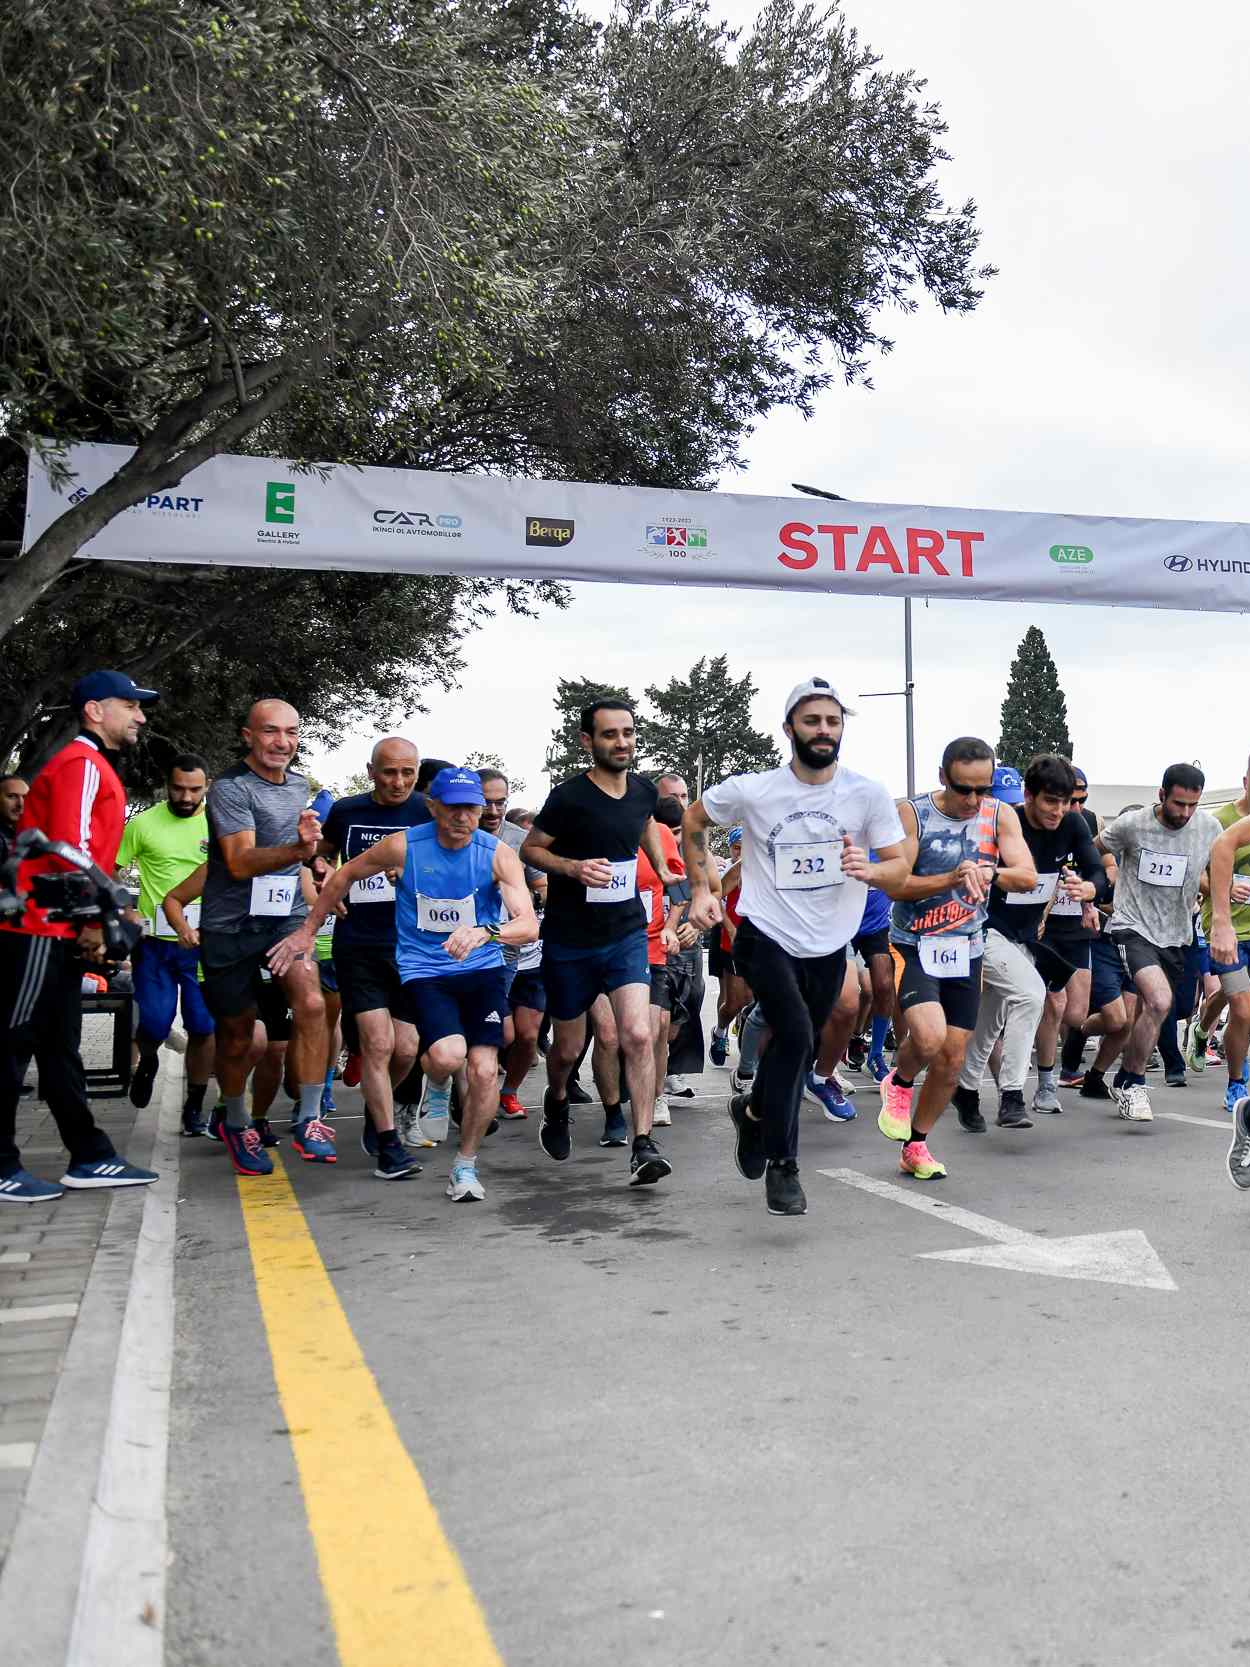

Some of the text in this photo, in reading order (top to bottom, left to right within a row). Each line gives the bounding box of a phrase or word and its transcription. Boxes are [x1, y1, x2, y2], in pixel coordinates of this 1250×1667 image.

[145, 495, 203, 511] PART
[373, 510, 434, 526] CAR
[257, 530, 300, 539] GALLERY
[669, 550, 687, 558] 100
[777, 522, 985, 577] START
[1058, 548, 1087, 561] AZE
[792, 858, 825, 874] 232
[1149, 862, 1173, 876] 212
[358, 876, 385, 891] 062
[605, 875, 627, 890] 84
[267, 888, 291, 904] 156
[429, 909, 460, 922] 060
[932, 949, 957, 964] 164
